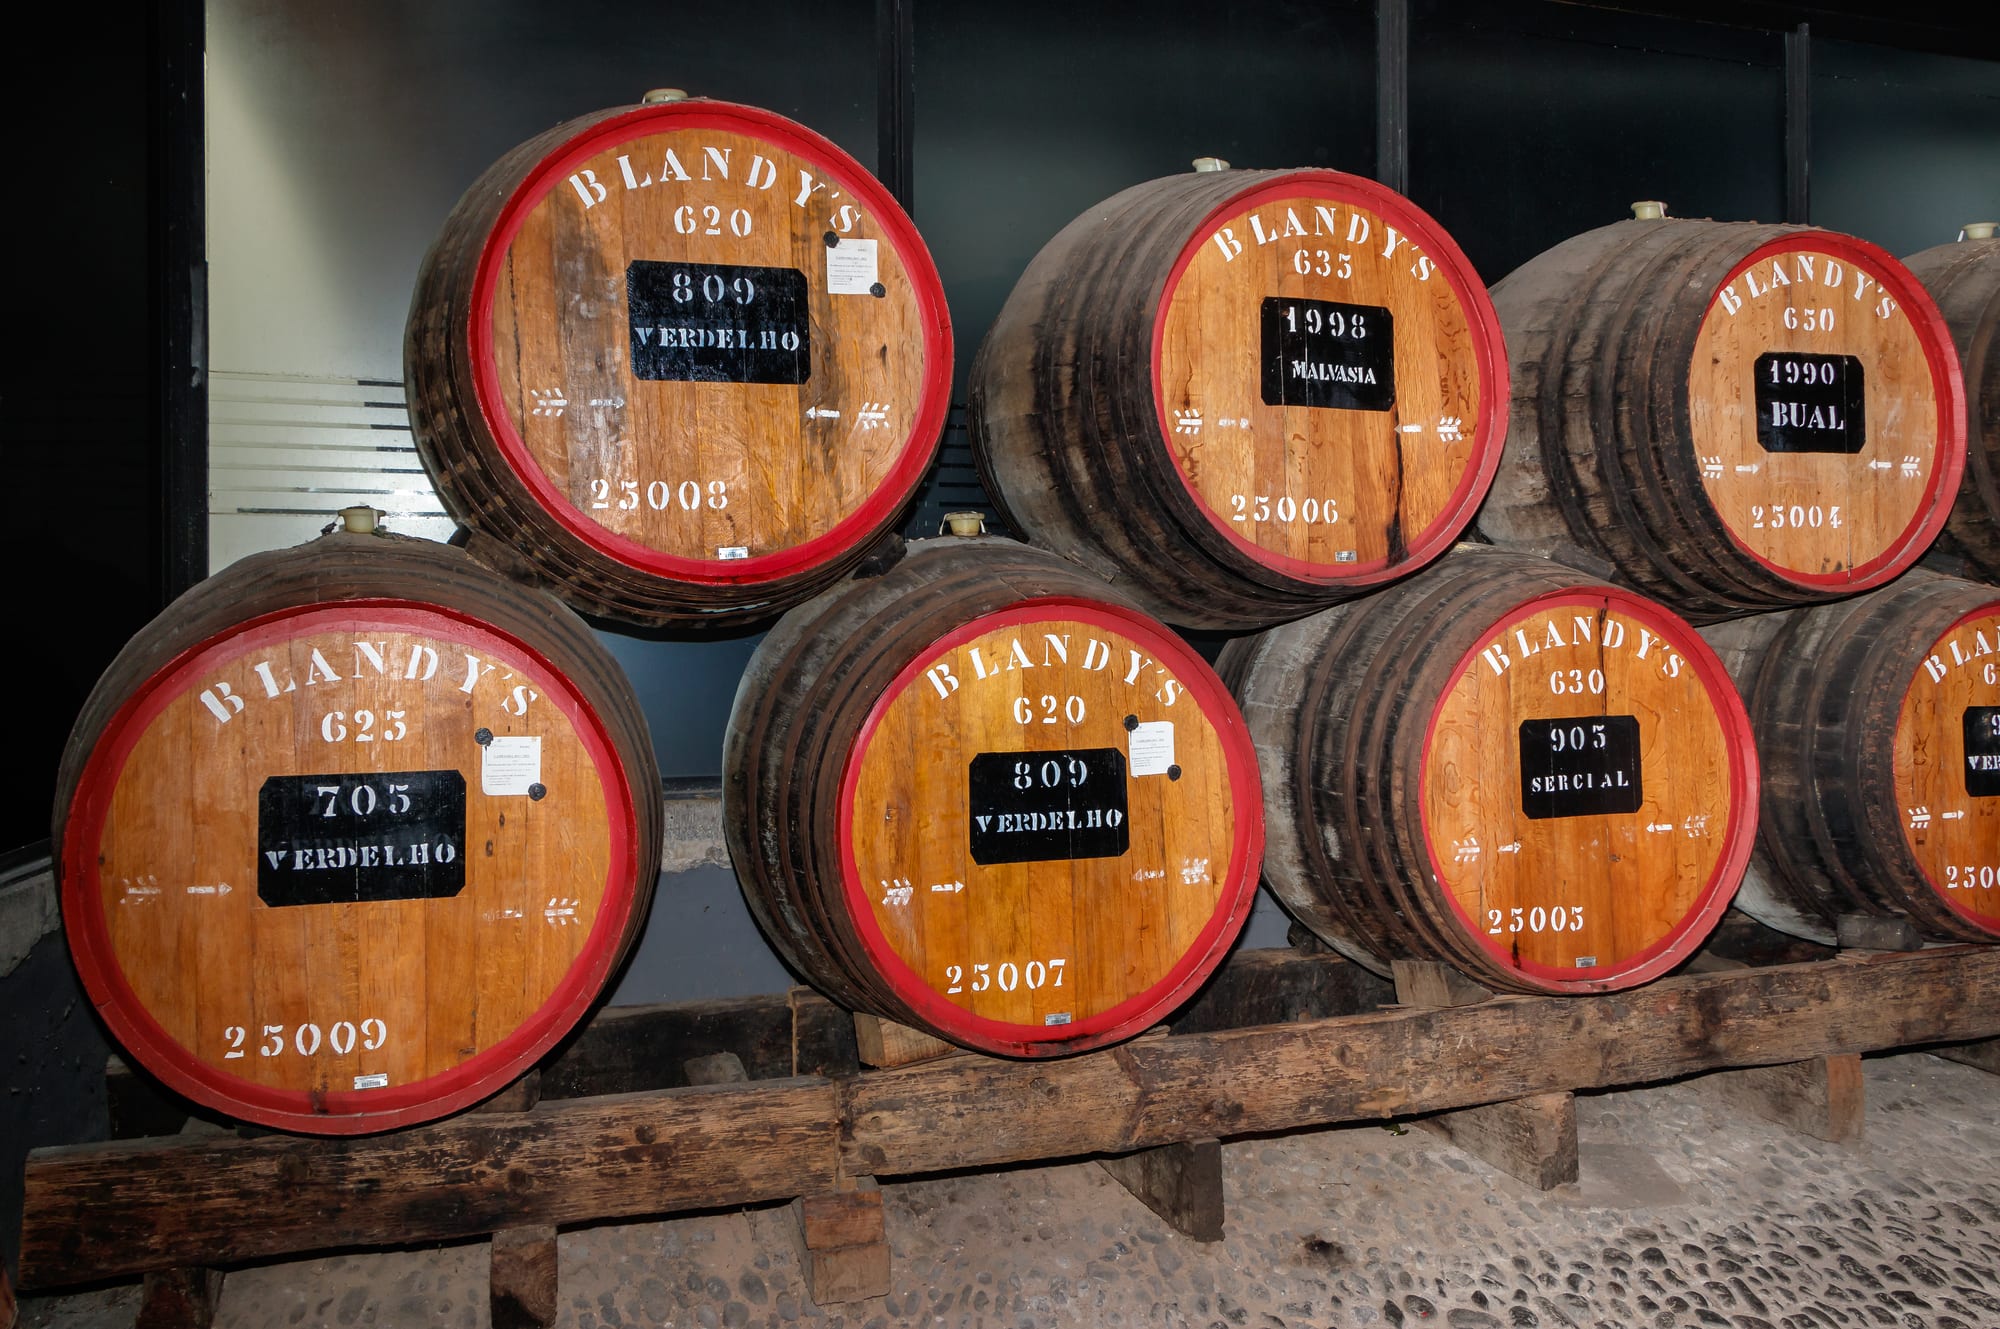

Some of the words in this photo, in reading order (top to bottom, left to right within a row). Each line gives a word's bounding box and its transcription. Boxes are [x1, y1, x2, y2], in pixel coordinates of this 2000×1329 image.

[569, 147, 862, 234] BLANDY'S
[674, 205, 753, 237] 620
[1213, 205, 1436, 281] BLANDY'S
[1294, 249, 1353, 280] 635
[672, 272, 755, 305] 809
[1718, 255, 1897, 320] BLANDY'S
[1286, 306, 1367, 339] 1998
[1783, 307, 1835, 332] 650
[635, 326, 801, 352] VERDELHO
[1291, 360, 1377, 385] MALVASIA
[1770, 360, 1835, 385] 1990
[1771, 401, 1845, 430] BUAL
[590, 478, 728, 511] 25008
[1231, 494, 1339, 524] 25006
[1751, 505, 1842, 529] 25004
[1482, 616, 1686, 678] BLANDY'S
[200, 640, 538, 725] BLANDY'S
[926, 633, 1184, 707] BLANDY'S
[1549, 668, 1605, 695] 630
[1013, 695, 1086, 725] 620
[321, 709, 408, 743] 625
[1549, 724, 1606, 752] 905
[1013, 759, 1088, 790] 809
[1531, 770, 1630, 794] SERCIAL
[316, 784, 411, 818] 705
[975, 808, 1123, 834] VERDELHO
[264, 842, 456, 872] VERDELHO
[1487, 906, 1584, 934] 25005
[945, 958, 1066, 994] 25007
[223, 1017, 388, 1060] 25009
